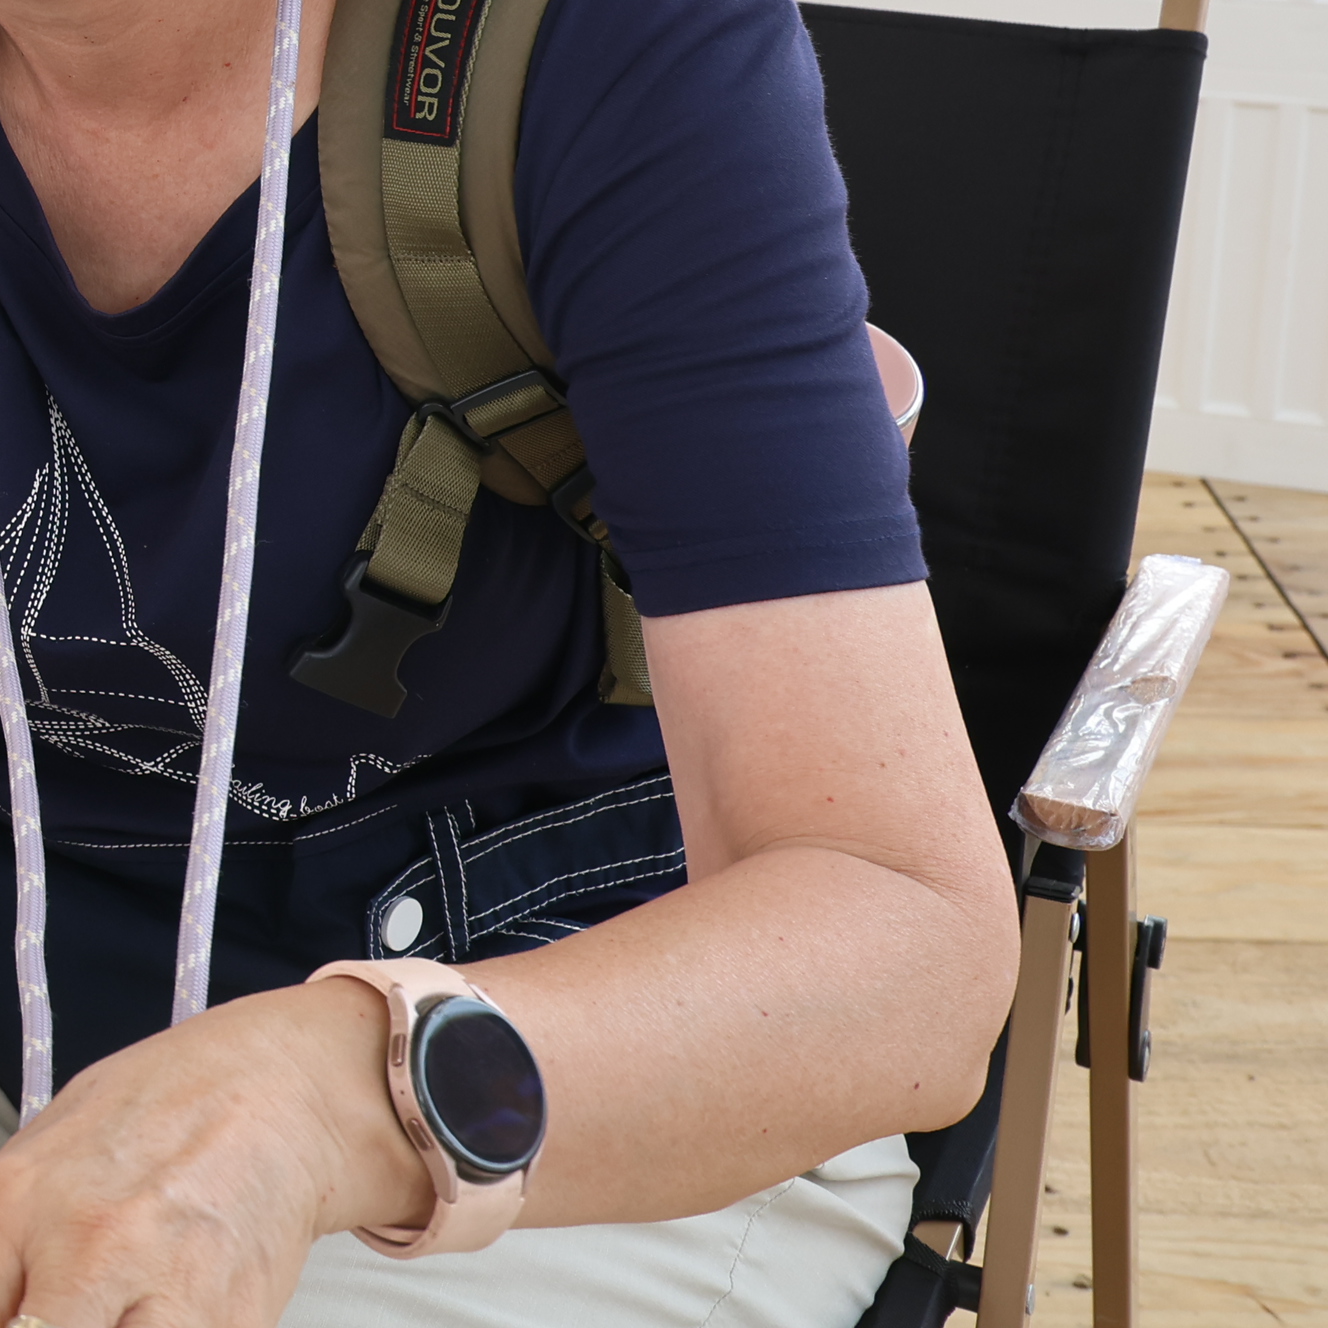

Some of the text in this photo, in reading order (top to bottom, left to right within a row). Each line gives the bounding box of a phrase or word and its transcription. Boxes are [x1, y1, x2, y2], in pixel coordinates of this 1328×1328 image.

[416, 5, 429, 32] Sport
[403, 45, 420, 106] Streetwear
[229, 770, 344, 819] ailing boat
